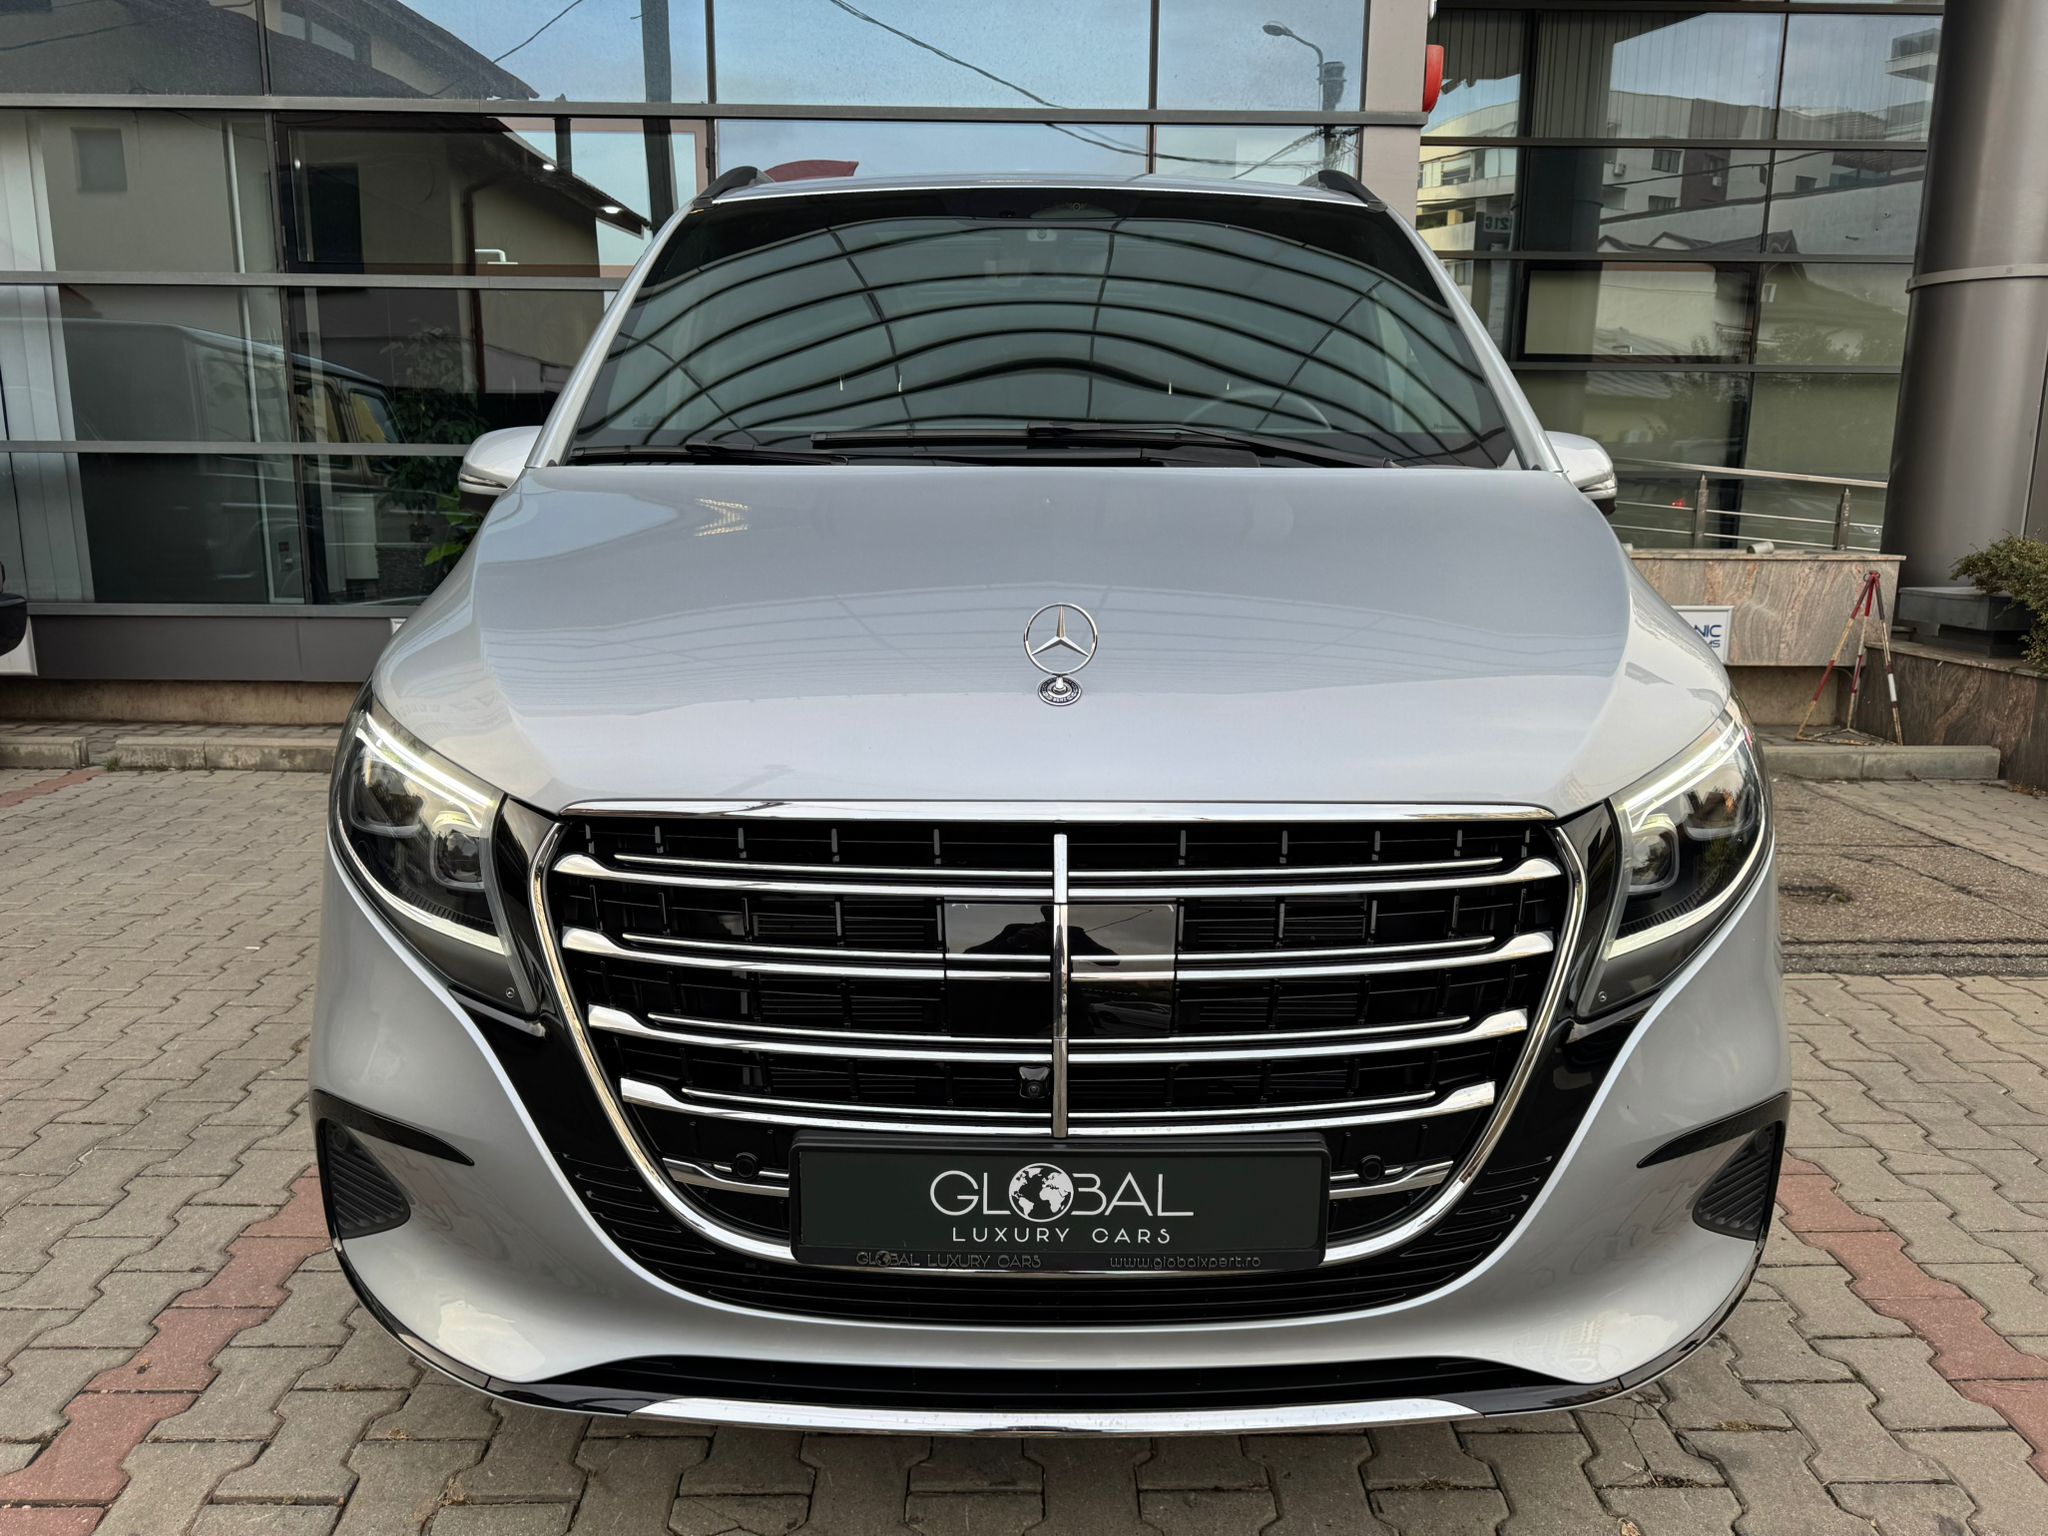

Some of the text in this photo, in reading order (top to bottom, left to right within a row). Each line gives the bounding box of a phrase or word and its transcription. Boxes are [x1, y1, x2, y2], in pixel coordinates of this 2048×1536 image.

[929, 1162, 1195, 1223] GLOBAL
[952, 1227, 1171, 1244] LUXURY CARS
[856, 1250, 1042, 1269] GLOBAL LUXURY CARS
[1110, 1256, 1262, 1270] www.globalxpert.ro
